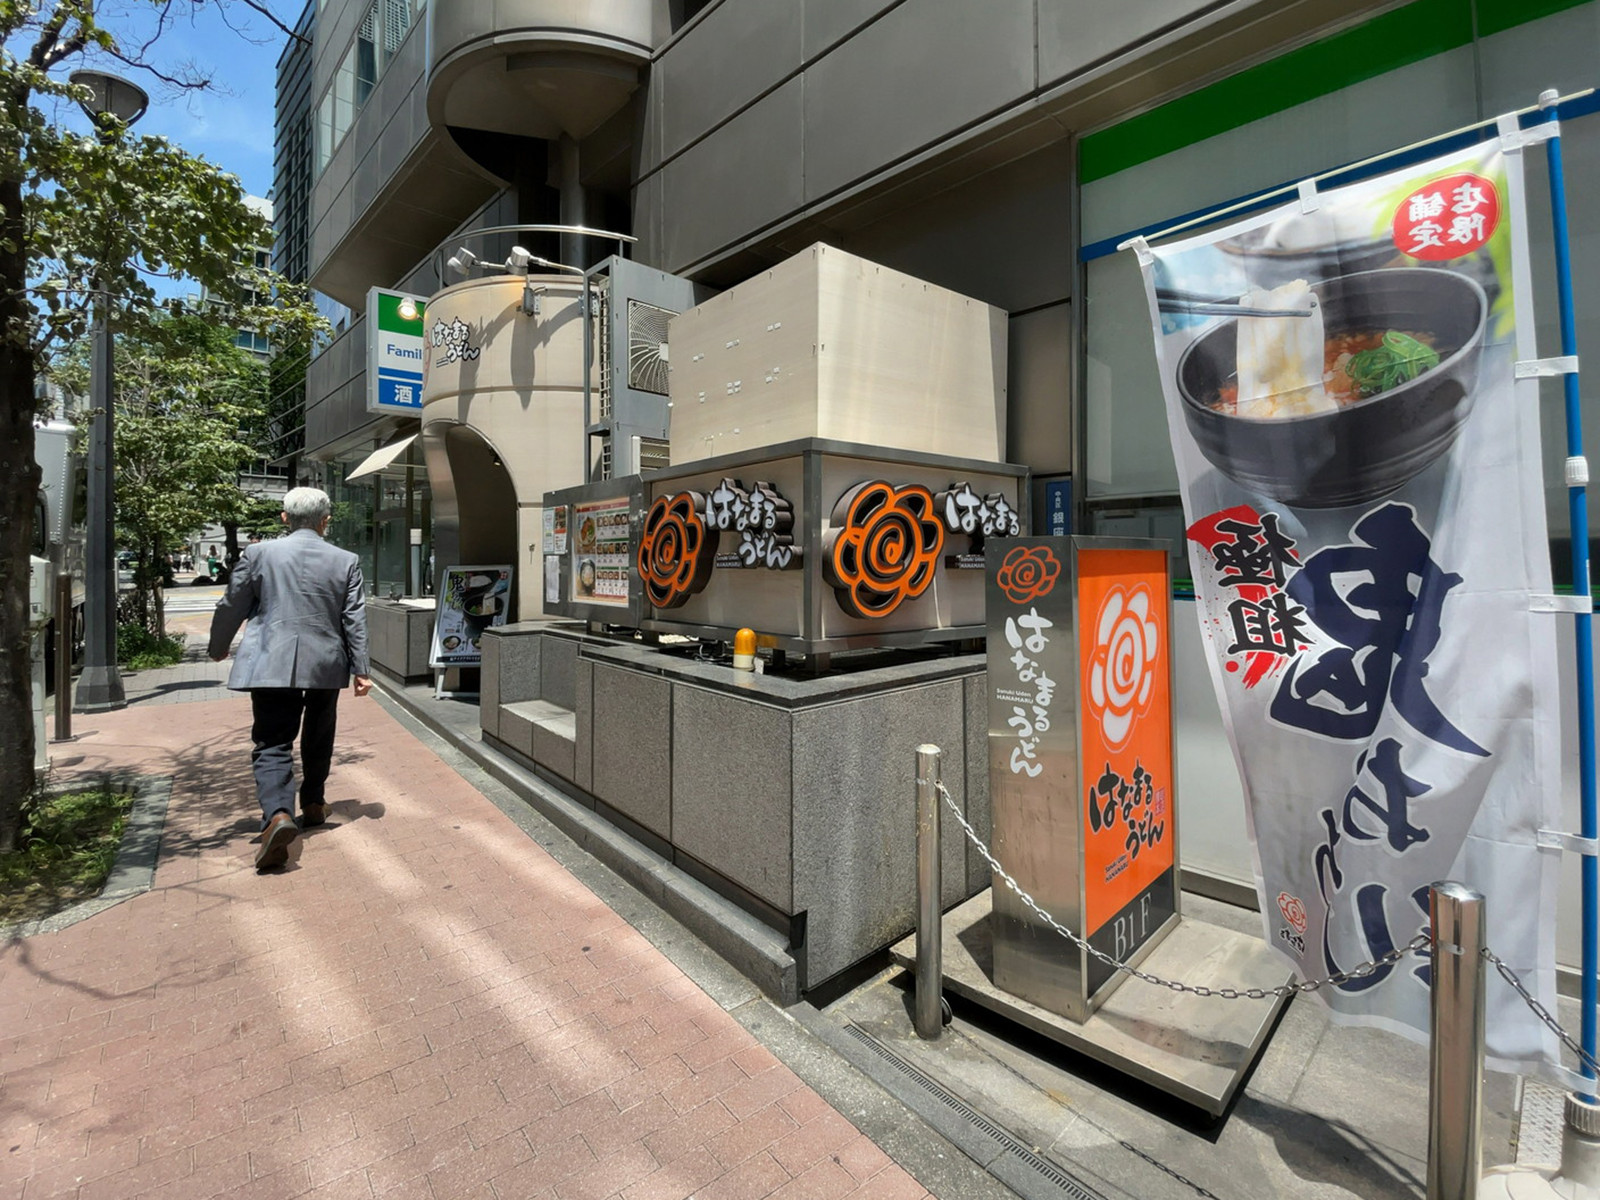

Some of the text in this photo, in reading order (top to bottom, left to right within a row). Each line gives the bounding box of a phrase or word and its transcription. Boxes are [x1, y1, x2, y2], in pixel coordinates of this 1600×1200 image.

[432, 316, 471, 348] はなまる
[447, 342, 480, 363] うどん
[705, 480, 776, 532] はなまる
[945, 484, 1020, 536] はなまる
[739, 531, 792, 568] うどん
[1089, 761, 1153, 832] はなまる
[1126, 811, 1164, 859] うどん
